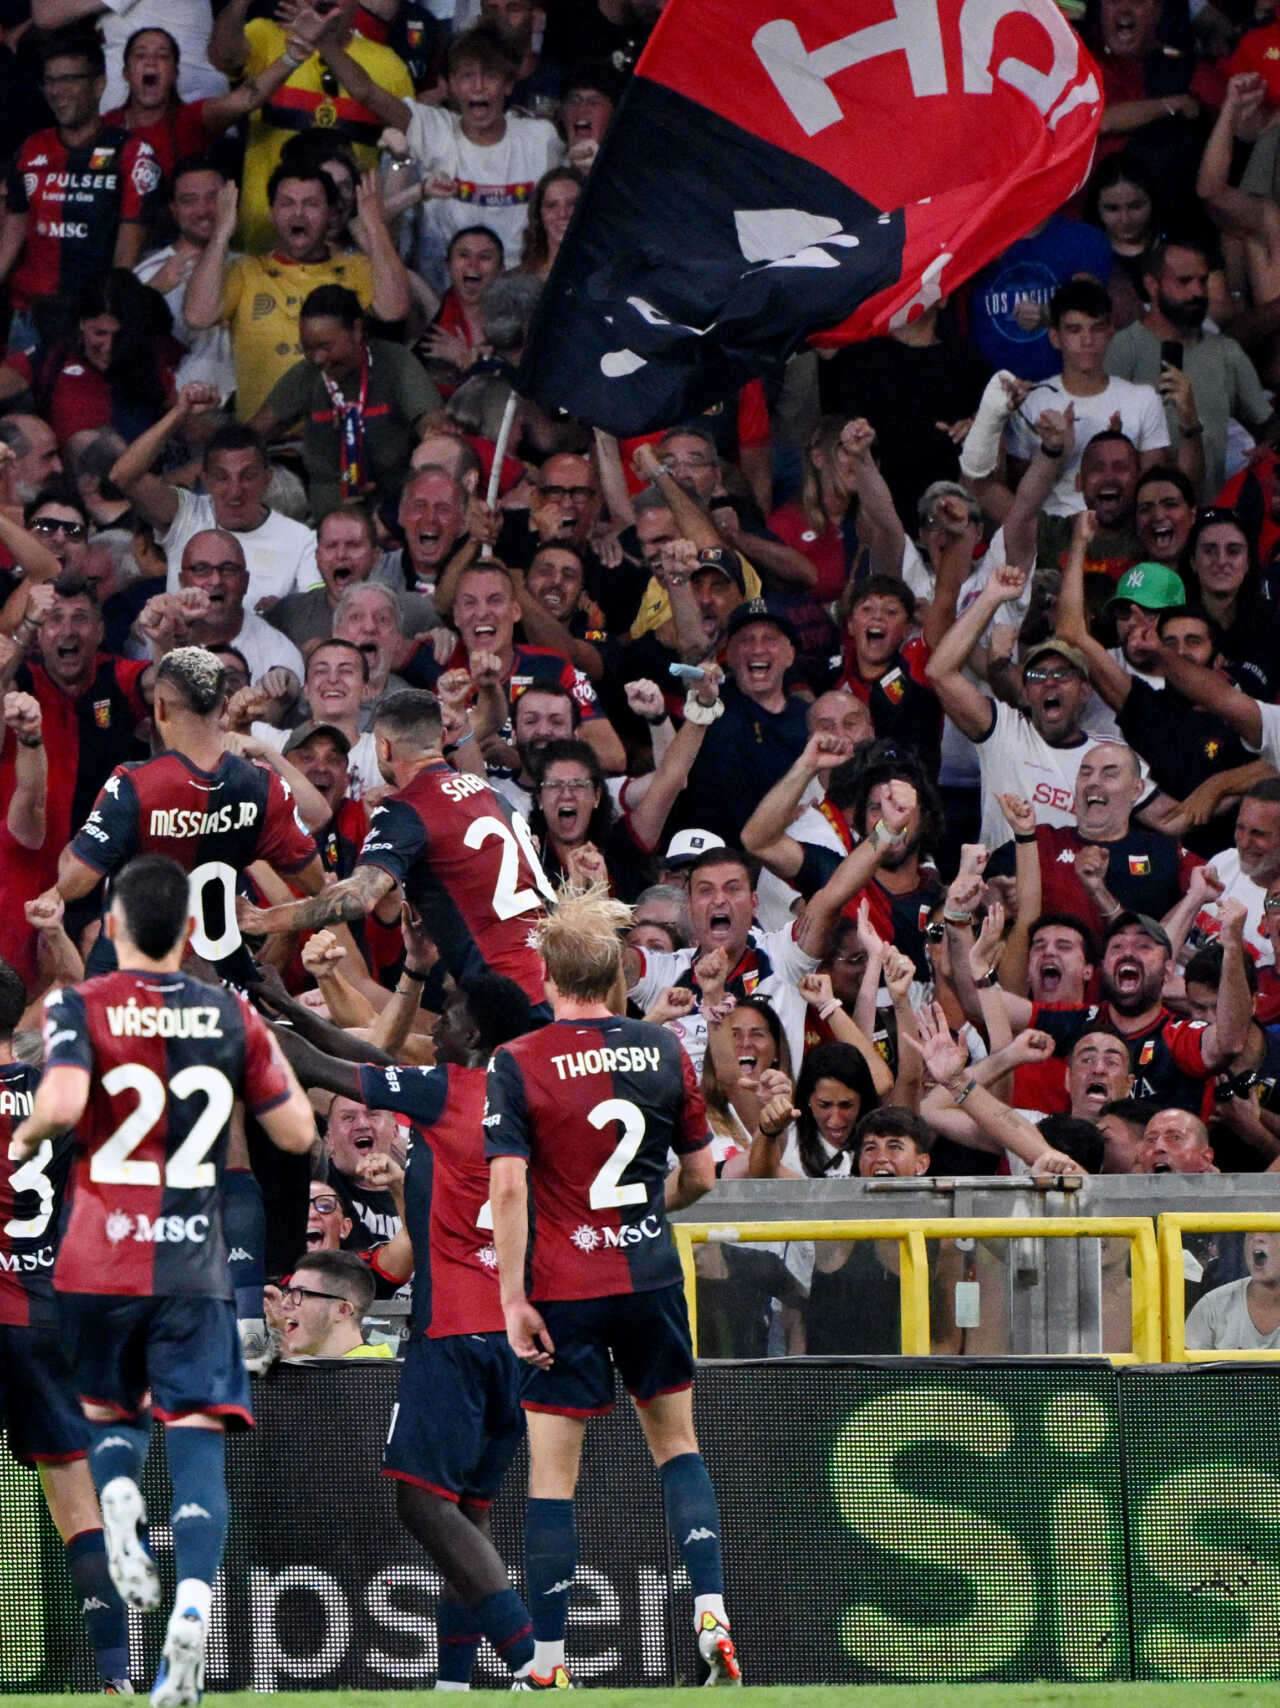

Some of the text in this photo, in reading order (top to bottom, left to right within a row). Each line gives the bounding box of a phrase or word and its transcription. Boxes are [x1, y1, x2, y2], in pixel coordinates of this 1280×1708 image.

[45, 172, 117, 190] PULSEE
[48, 221, 89, 238] MSC
[1032, 782, 1078, 816] SE
[150, 802, 258, 838] MESSIAS JR
[107, 997, 223, 1039] VÁSQUEZ
[551, 1047, 660, 1080] THORSBY
[90, 1063, 233, 1188] 22
[587, 1099, 648, 1210] 2
[134, 1214, 210, 1243] MSC
[601, 1214, 662, 1249] MSC
